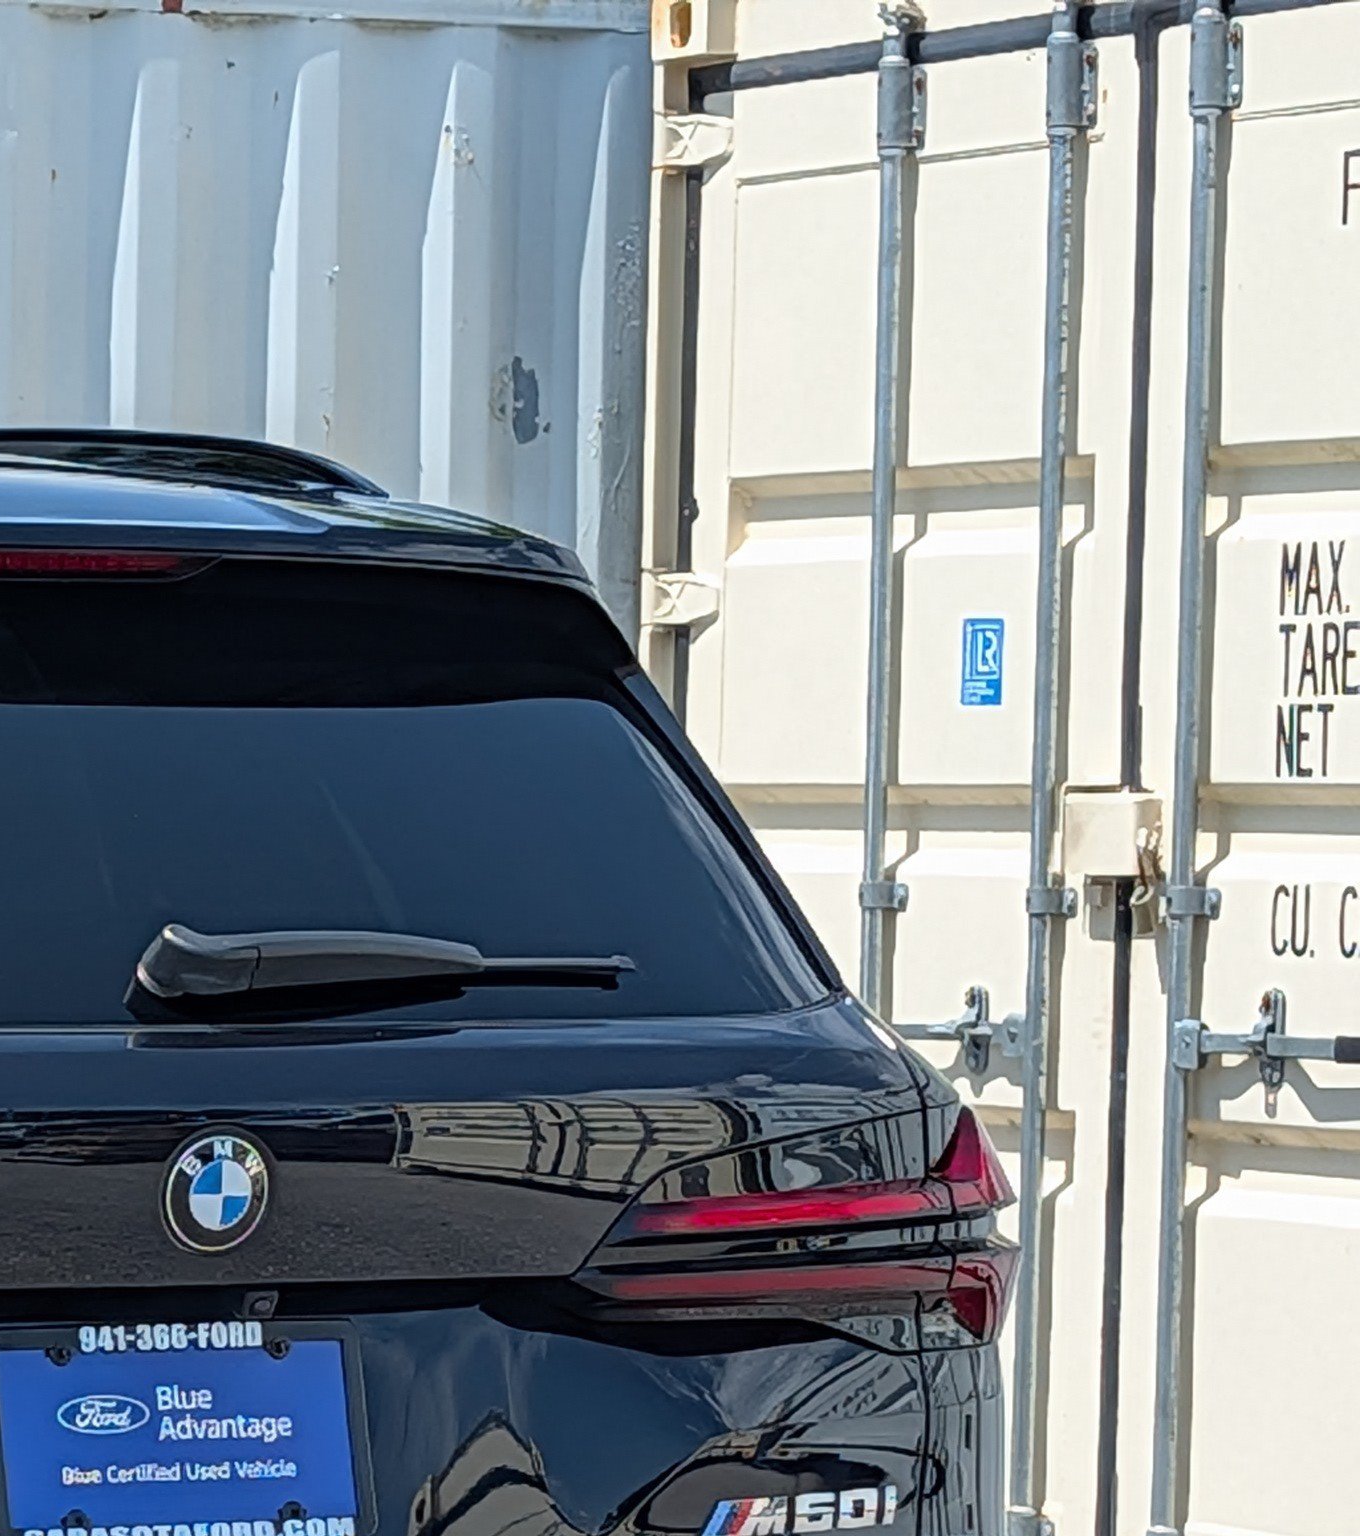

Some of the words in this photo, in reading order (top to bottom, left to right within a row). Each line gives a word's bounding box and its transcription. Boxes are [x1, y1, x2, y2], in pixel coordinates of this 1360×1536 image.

[1279, 539, 1351, 616] MAX.
[1279, 620, 1360, 697] TARE
[1276, 703, 1335, 777] NET
[1271, 883, 1315, 958] CU.
[180, 1138, 266, 1177] BMW
[78, 1321, 263, 1353] 941-366-FORD
[75, 1400, 132, 1428] Ford
[156, 1385, 213, 1411] Blue
[158, 1413, 293, 1443] Advantage
[106, 1462, 180, 1483] Certified
[185, 1461, 230, 1480] Used
[234, 1458, 297, 1479] Vehicle
